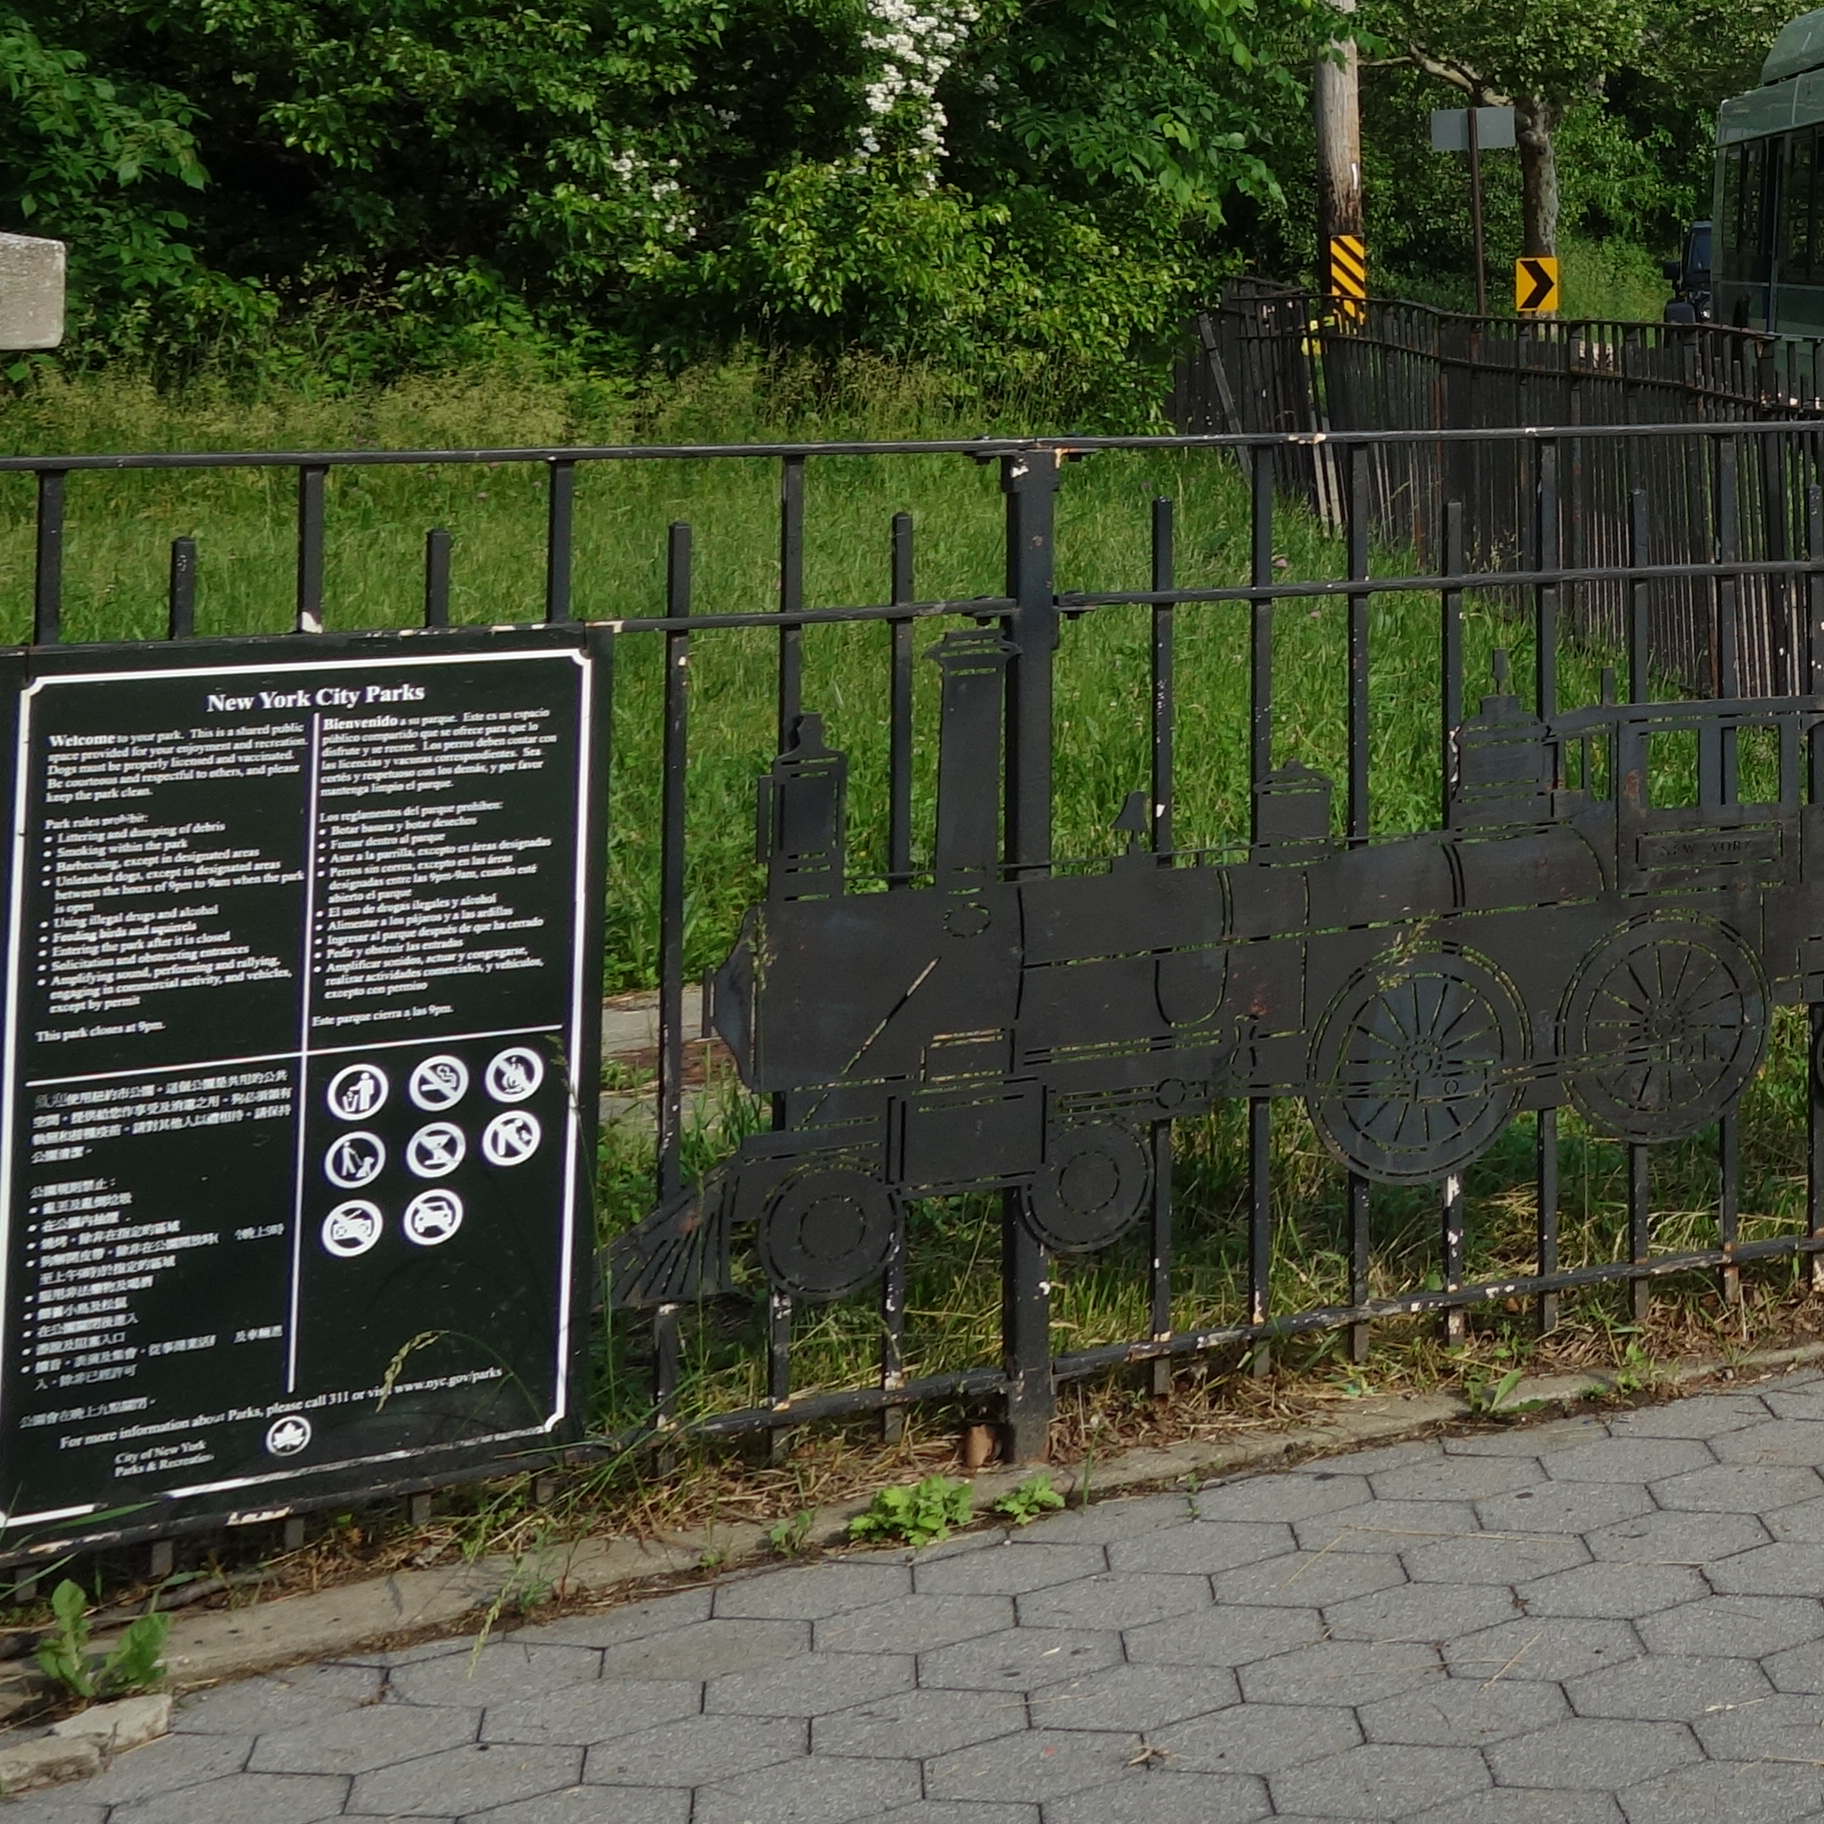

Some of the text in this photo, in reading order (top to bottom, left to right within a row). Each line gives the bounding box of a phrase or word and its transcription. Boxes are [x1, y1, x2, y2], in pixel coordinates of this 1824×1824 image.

[206, 682, 425, 712] New York City Parks
[49, 733, 115, 747] Welcome
[116, 732, 128, 742] to
[130, 733, 155, 744] your
[156, 729, 183, 743] park.
[190, 727, 214, 738] This
[215, 726, 225, 736] is
[235, 723, 270, 735] shared
[271, 721, 304, 736] public
[322, 715, 398, 730] Bienvenido
[47, 752, 79, 764] space
[80, 746, 129, 762] provided
[130, 745, 147, 756] for
[149, 746, 174, 757] your
[232, 738, 253, 749] and
[46, 762, 77, 777] Dogs
[78, 761, 106, 772] must
[107, 760, 121, 770] be
[122, 757, 168, 772] properly
[215, 752, 236, 763] and
[46, 777, 63, 788] Be
[119, 772, 140, 783] and
[141, 769, 194, 785] respectful
[195, 768, 207, 778] to
[208, 765, 244, 780] others,
[245, 764, 266, 775] and
[266, 762, 300, 776] please
[45, 785, 153, 805] keep the park clean.
[44, 817, 70, 829] Park
[72, 815, 100, 827] rules
[57, 820, 226, 845] Littering and dumping of debris
[56, 843, 106, 859] Smoking
[144, 839, 162, 850] the
[163, 837, 188, 851] park
[54, 869, 305, 899] between the hours of 9pm to 9am when the park
[114, 869, 144, 884] dogs,
[145, 866, 181, 881] except
[182, 865, 195, 875] in
[195, 860, 252, 877] designated
[253, 860, 281, 870] areas
[53, 902, 94, 915] is open
[53, 903, 219, 930] Using illegal drugs and alcohol
[51, 930, 231, 959] Entering the park after it is closed
[115, 966, 152, 982] sound,
[153, 960, 213, 978] performing
[214, 958, 235, 970] and
[236, 954, 281, 971] rallying,
[49, 994, 140, 1016] except by permit
[34, 1018, 166, 1041] This park closes at 9pm.
[60, 1433, 82, 1448] For
[84, 1430, 117, 1444] more
[118, 1416, 190, 1438] information
[227, 1404, 264, 1424] Parks,
[265, 1397, 303, 1417] please
[304, 1393, 327, 1408] call
[328, 1390, 349, 1404] 311
[351, 1390, 365, 1400] or
[394, 1365, 502, 1396] www.nyc.gov/parks
